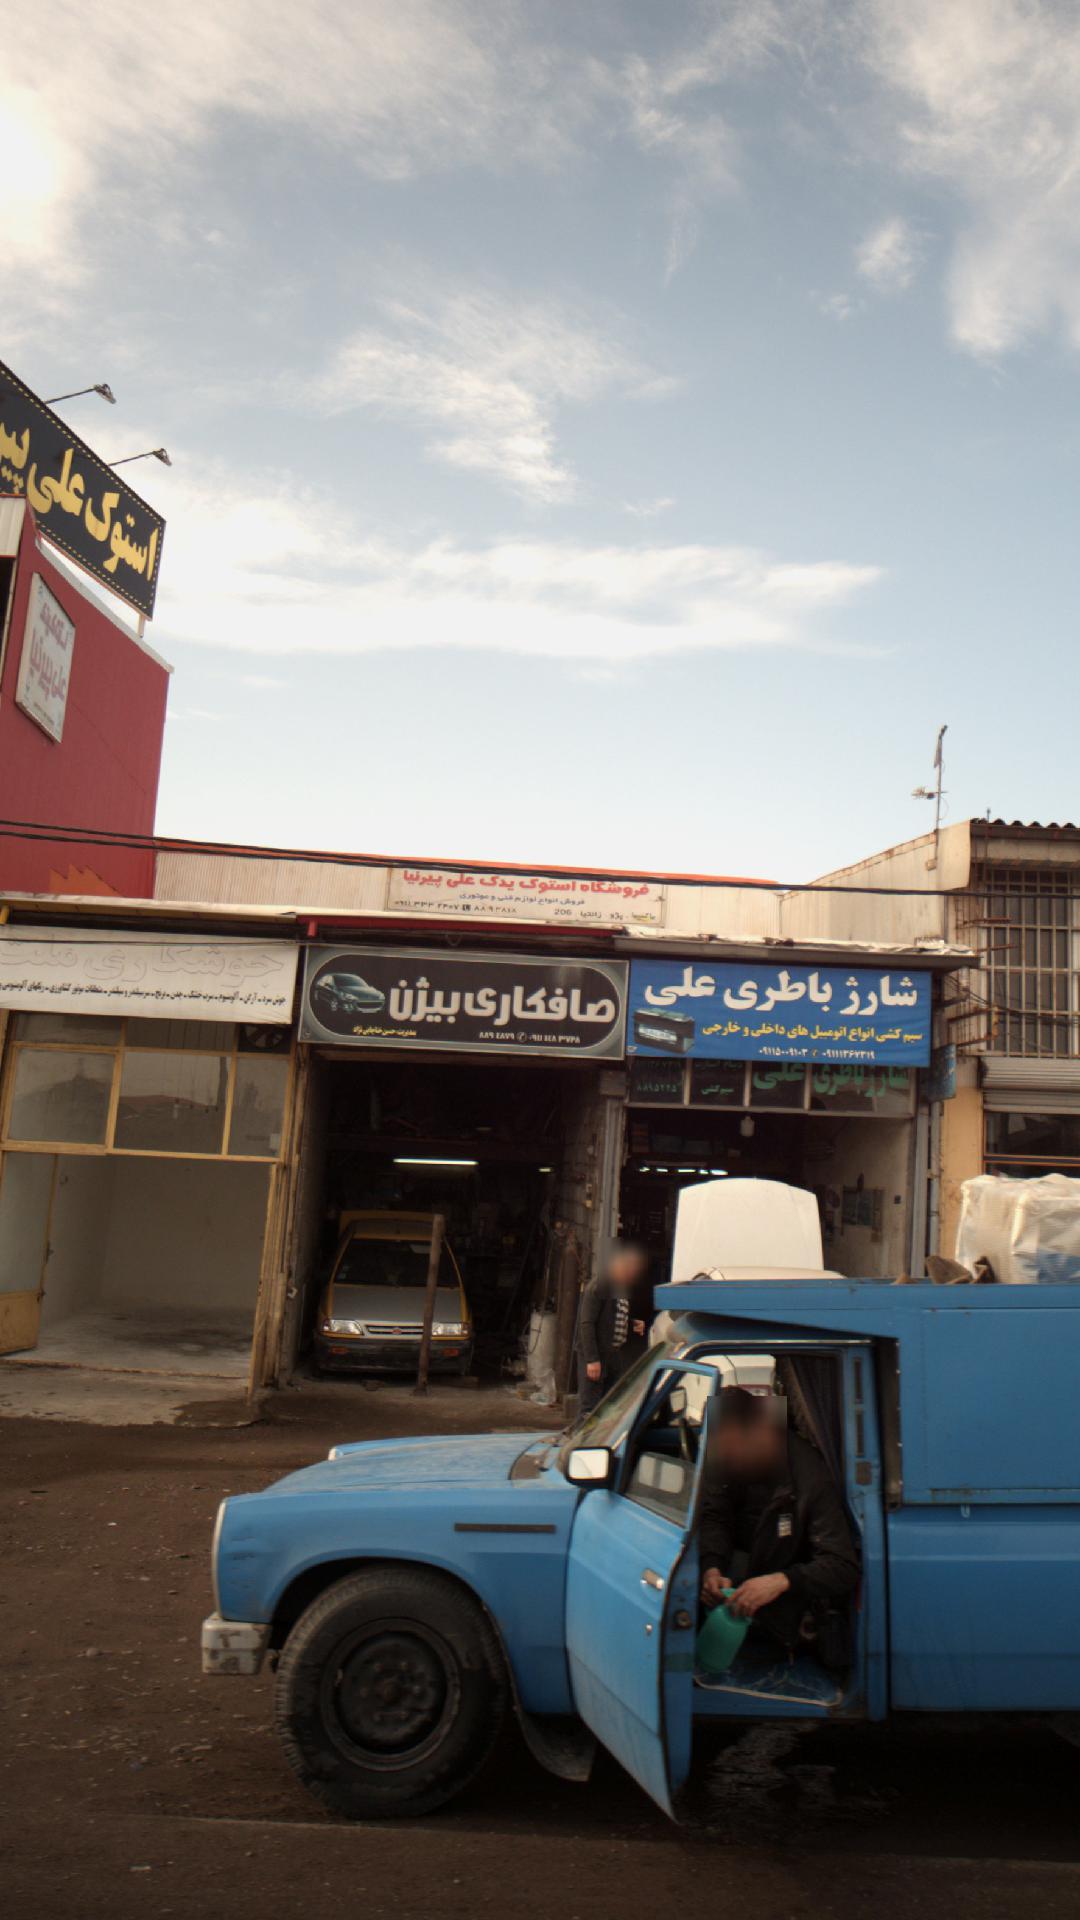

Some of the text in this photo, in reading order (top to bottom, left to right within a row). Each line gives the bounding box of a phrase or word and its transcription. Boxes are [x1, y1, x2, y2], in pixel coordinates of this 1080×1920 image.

[27, 448, 86, 517] علی
[85, 492, 159, 581] استوک
[403, 870, 650, 898] فروشگاه استوک یدک علی پیرنیا
[554, 908, 572, 916] 206
[389, 975, 616, 1026] صافکاری بیژن
[644, 966, 918, 1015] شارژ باطری علی
[702, 1021, 923, 1044] سیم کشی انواع اتومبیل های داخلی و خارجی
